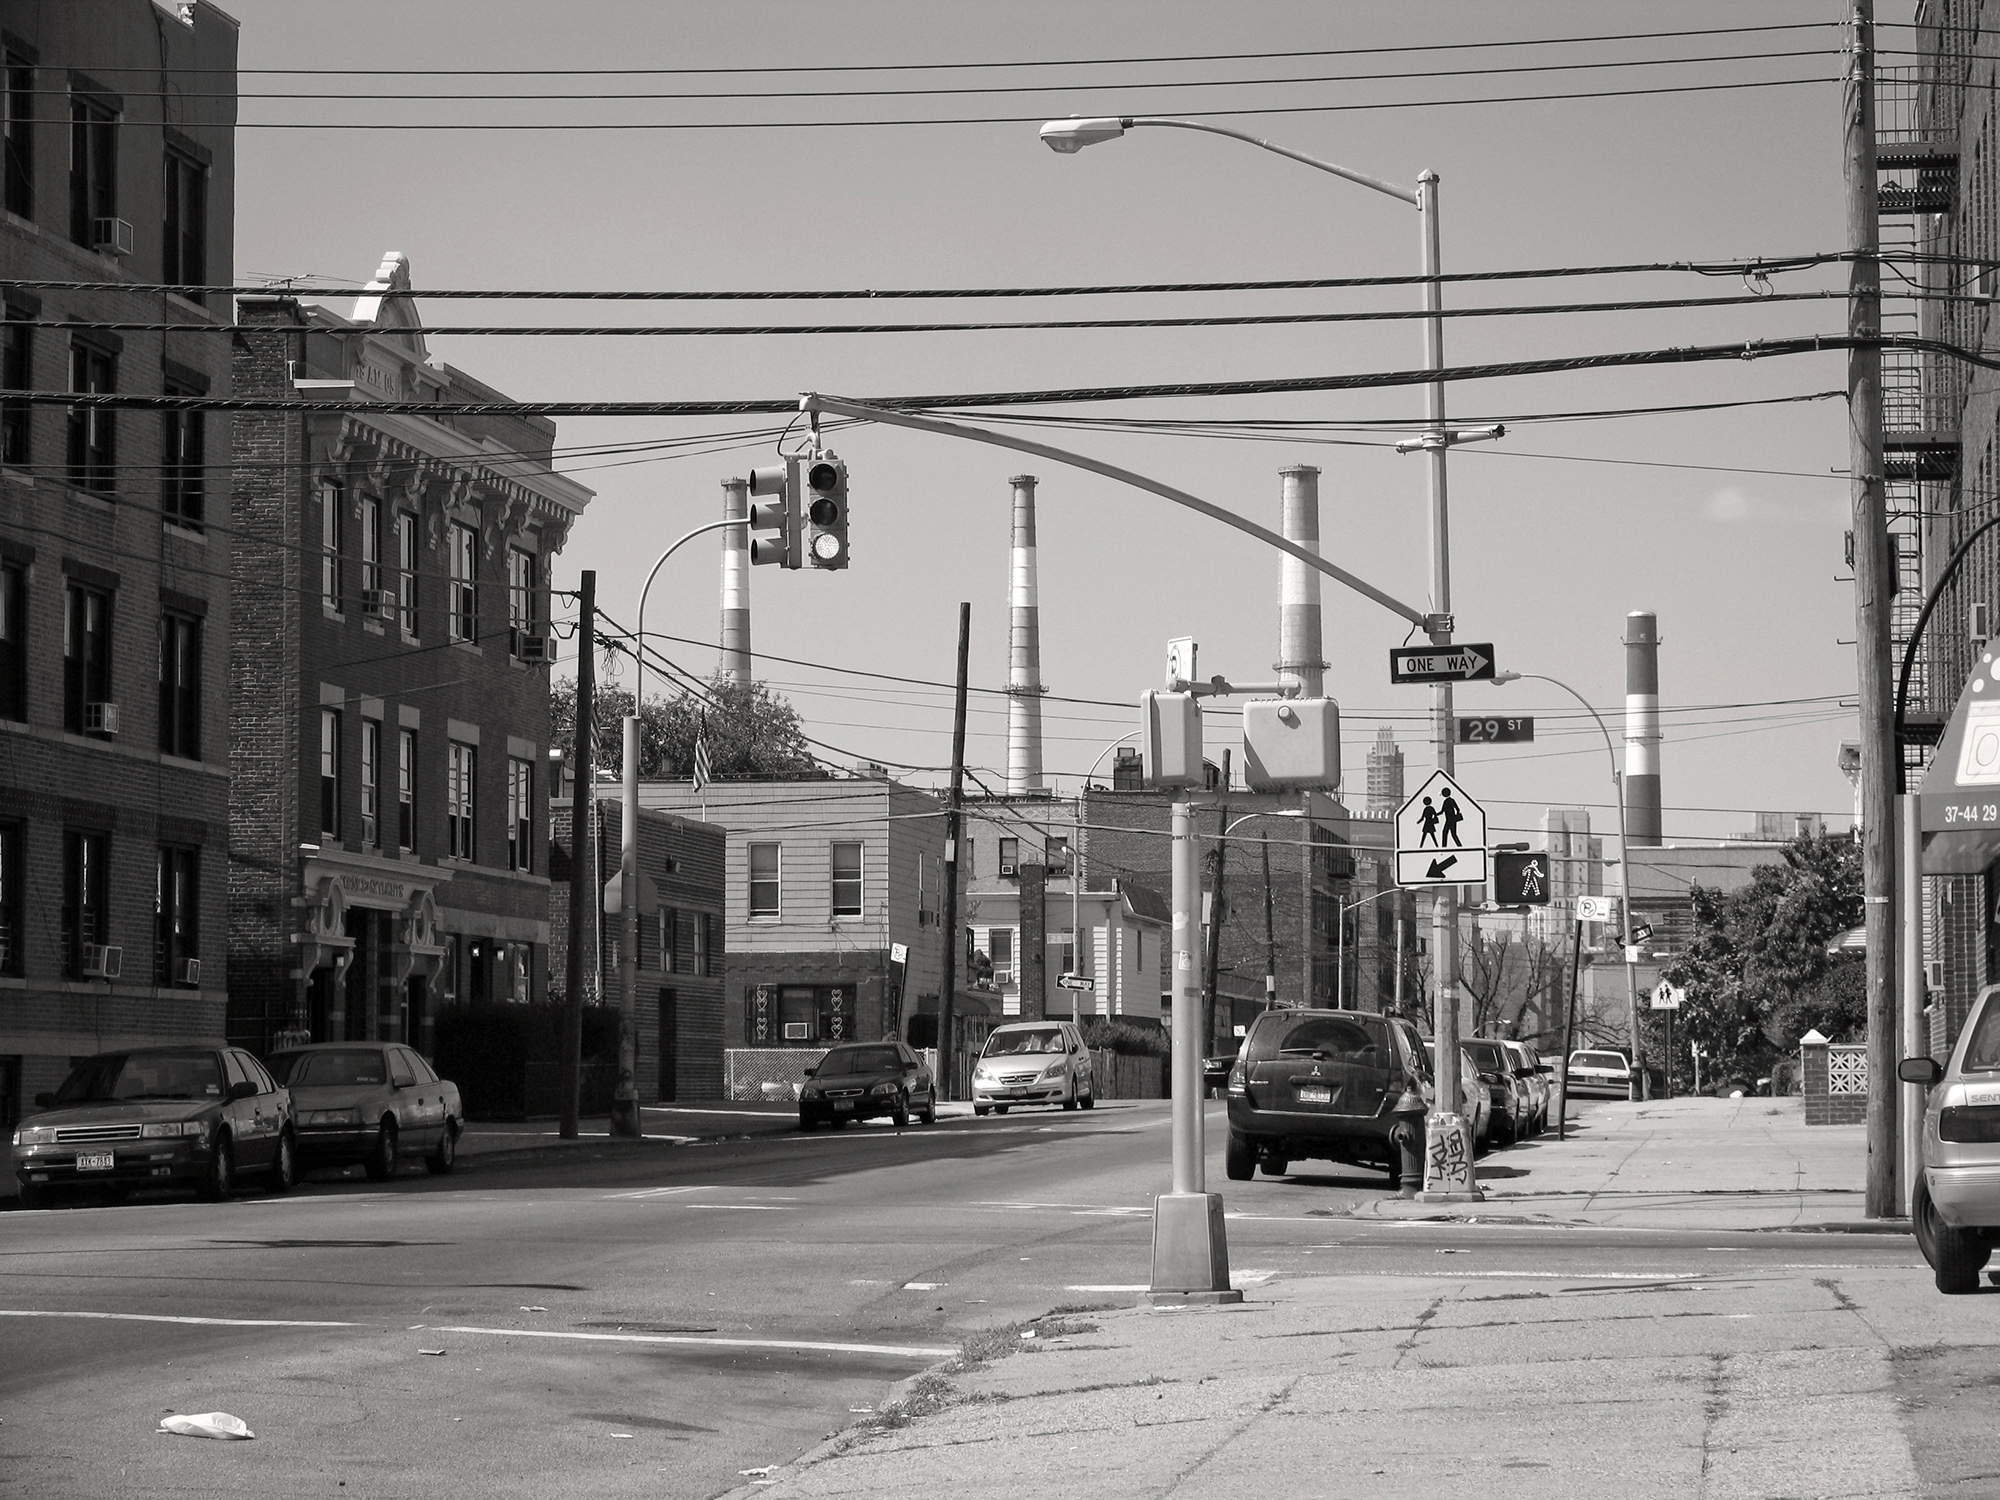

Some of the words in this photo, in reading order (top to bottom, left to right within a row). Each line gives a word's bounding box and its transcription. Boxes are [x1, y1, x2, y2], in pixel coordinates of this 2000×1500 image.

[1406, 657, 1435, 673] ONE
[1446, 655, 1478, 671] WAY
[1468, 719, 1500, 741] 29
[1507, 719, 1523, 731] ST
[1945, 805, 1979, 823] 37-44
[1982, 804, 1998, 822] 29
